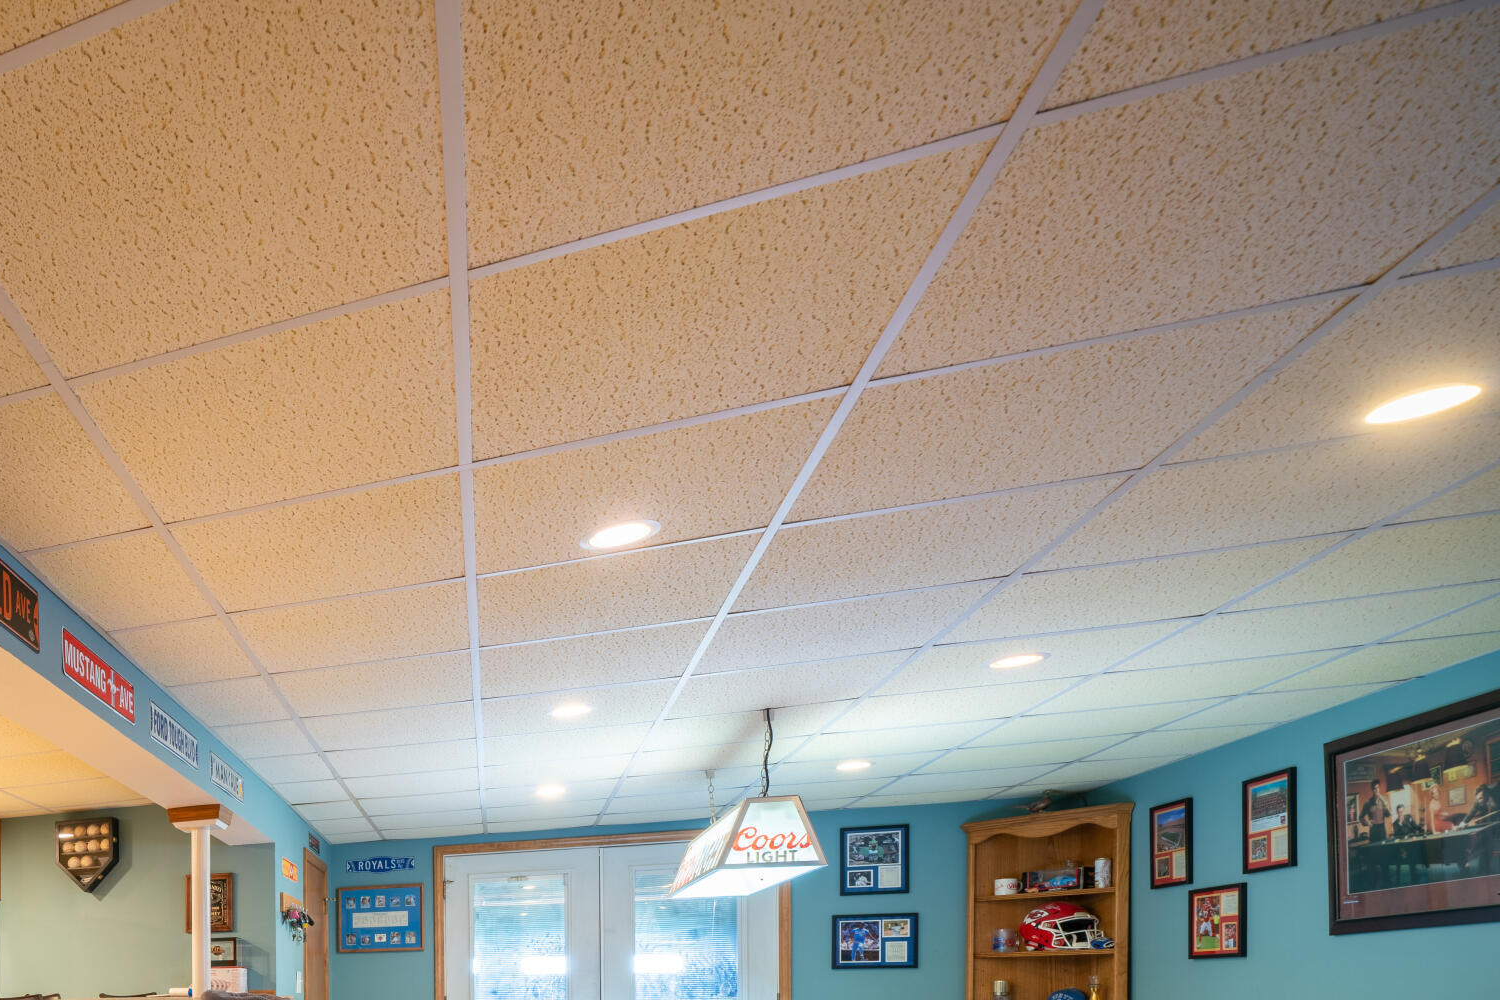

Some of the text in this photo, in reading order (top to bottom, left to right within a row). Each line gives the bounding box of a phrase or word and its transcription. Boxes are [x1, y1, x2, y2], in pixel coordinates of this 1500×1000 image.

[15, 590, 31, 625] AVE
[64, 639, 134, 715] MUSTANG AVE
[153, 708, 168, 742] FORD
[168, 720, 185, 757] TOUGH
[731, 826, 812, 851] Coors
[358, 859, 396, 870] ROYALS
[746, 850, 798, 863] LIGHT
